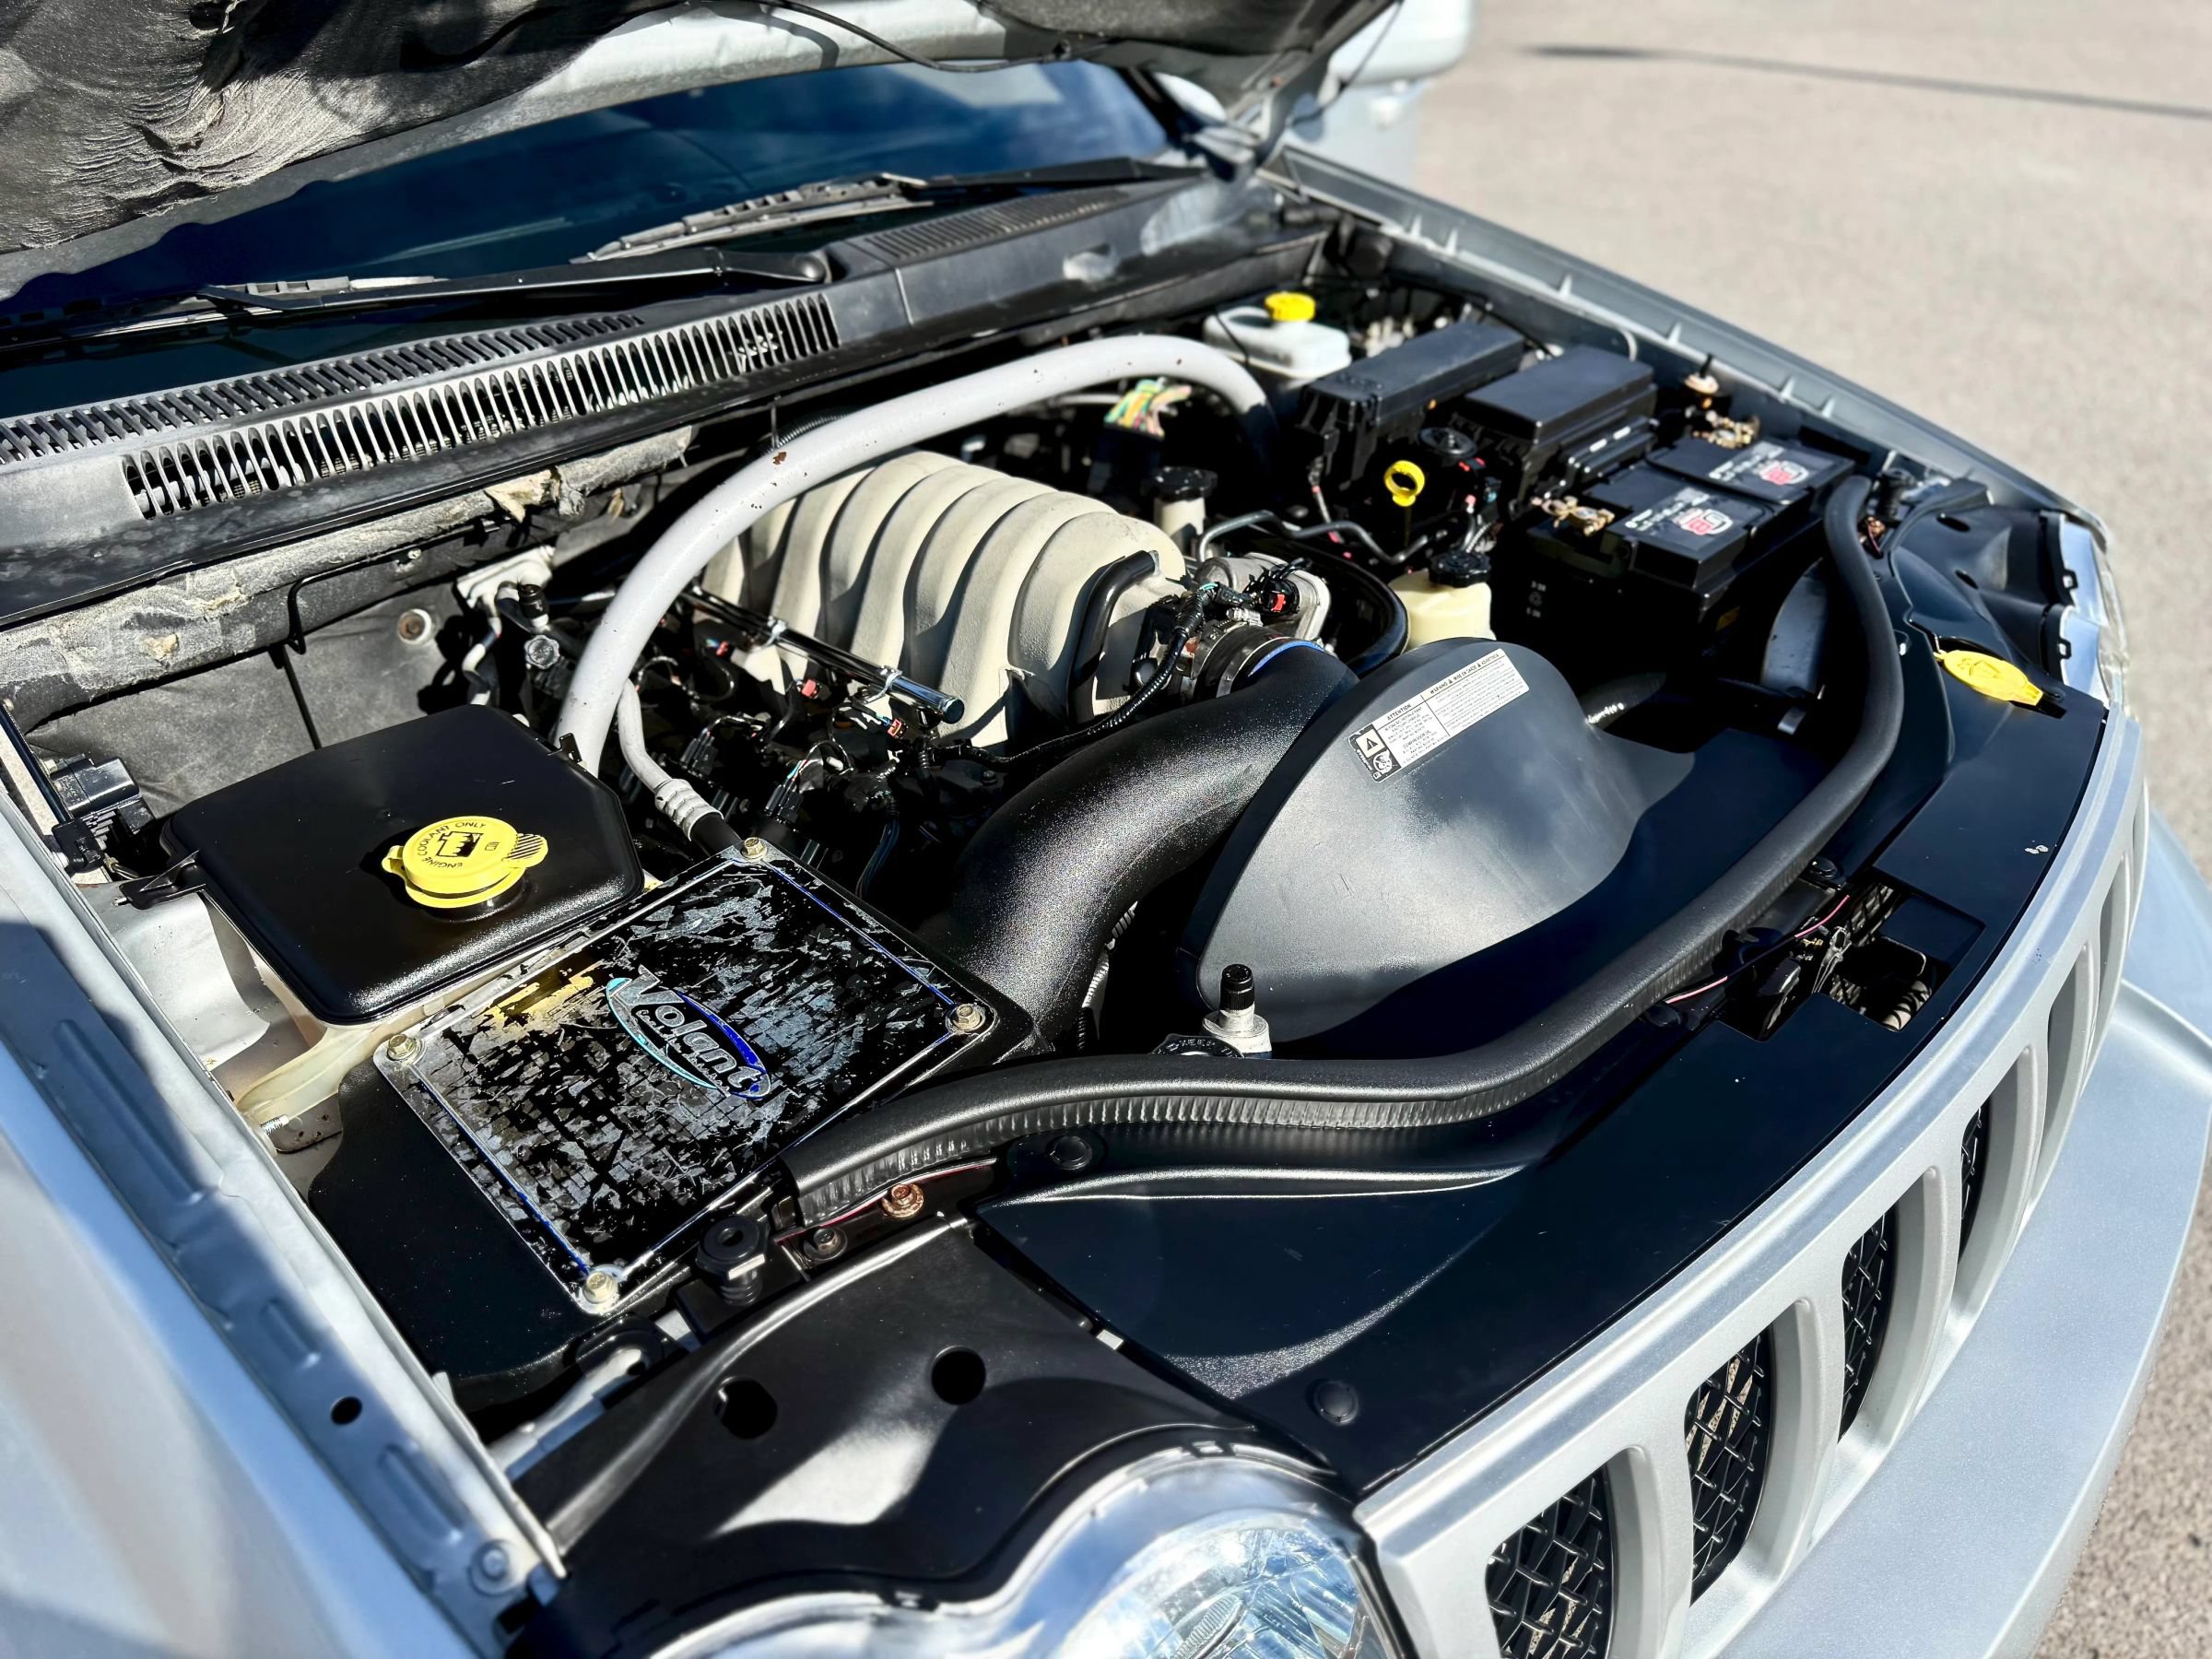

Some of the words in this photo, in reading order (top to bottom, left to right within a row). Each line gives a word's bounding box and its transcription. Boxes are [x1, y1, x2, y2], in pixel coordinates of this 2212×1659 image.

[1387, 703, 1411, 721] ATTENTION
[417, 825, 450, 856] COOLANT
[421, 856, 463, 868] ENGINE
[612, 964, 763, 1088] Volant
